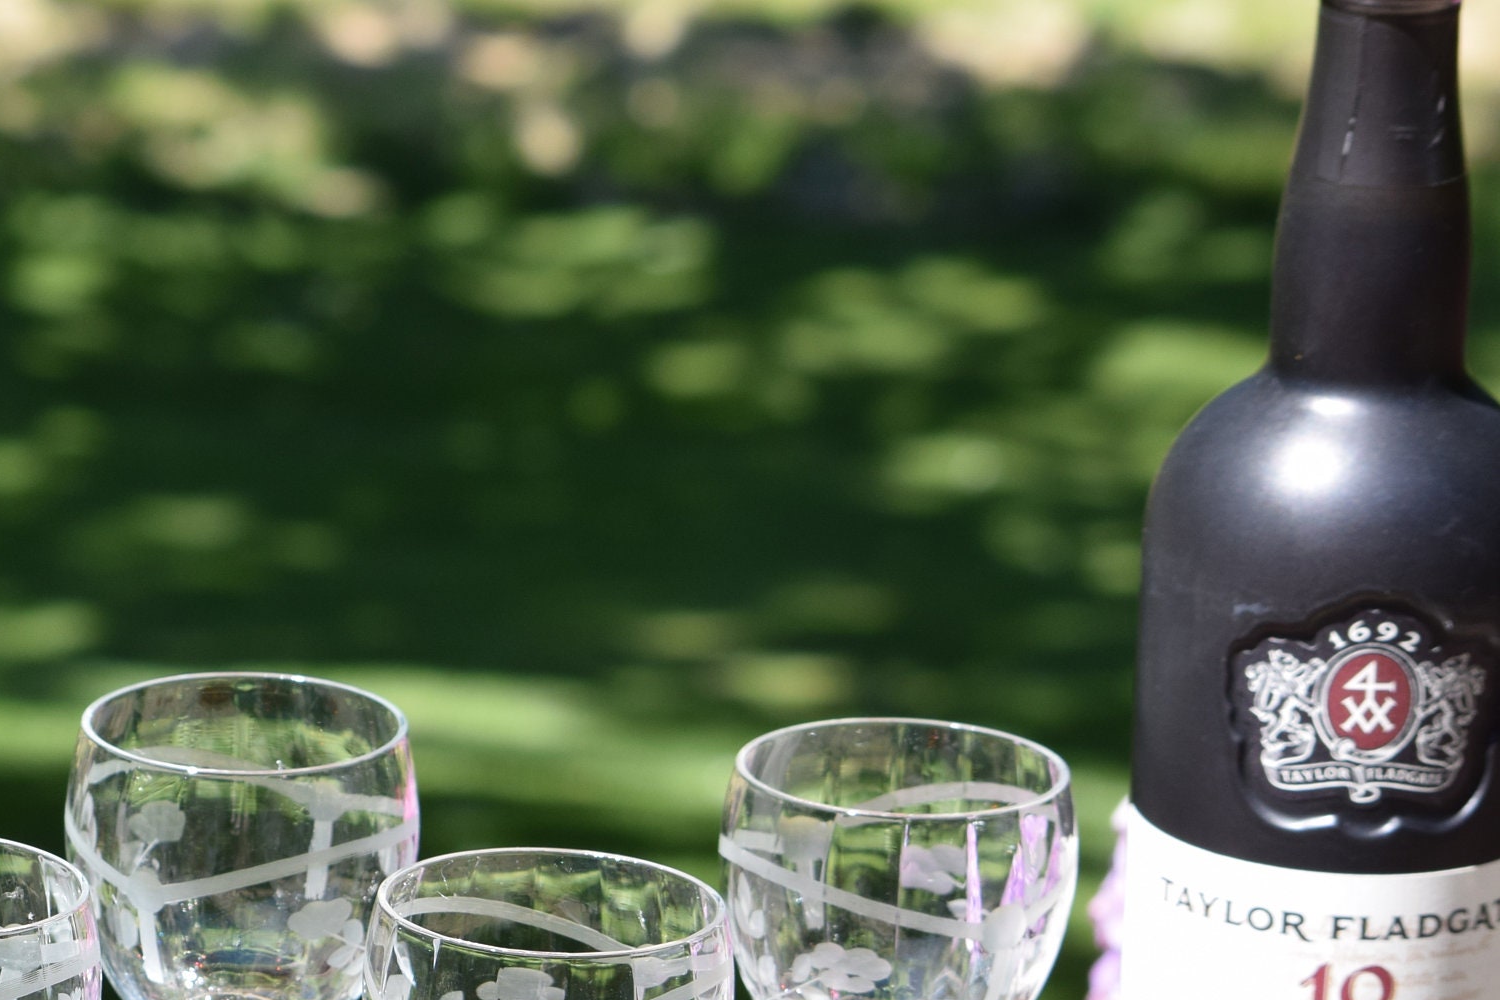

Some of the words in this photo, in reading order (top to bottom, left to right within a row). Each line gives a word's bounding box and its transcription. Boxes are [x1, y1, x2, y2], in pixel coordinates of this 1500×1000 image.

[1329, 620, 1421, 652] 1692
[1281, 766, 1350, 782] TAYLOR
[1160, 876, 1313, 943] TAYLOR
